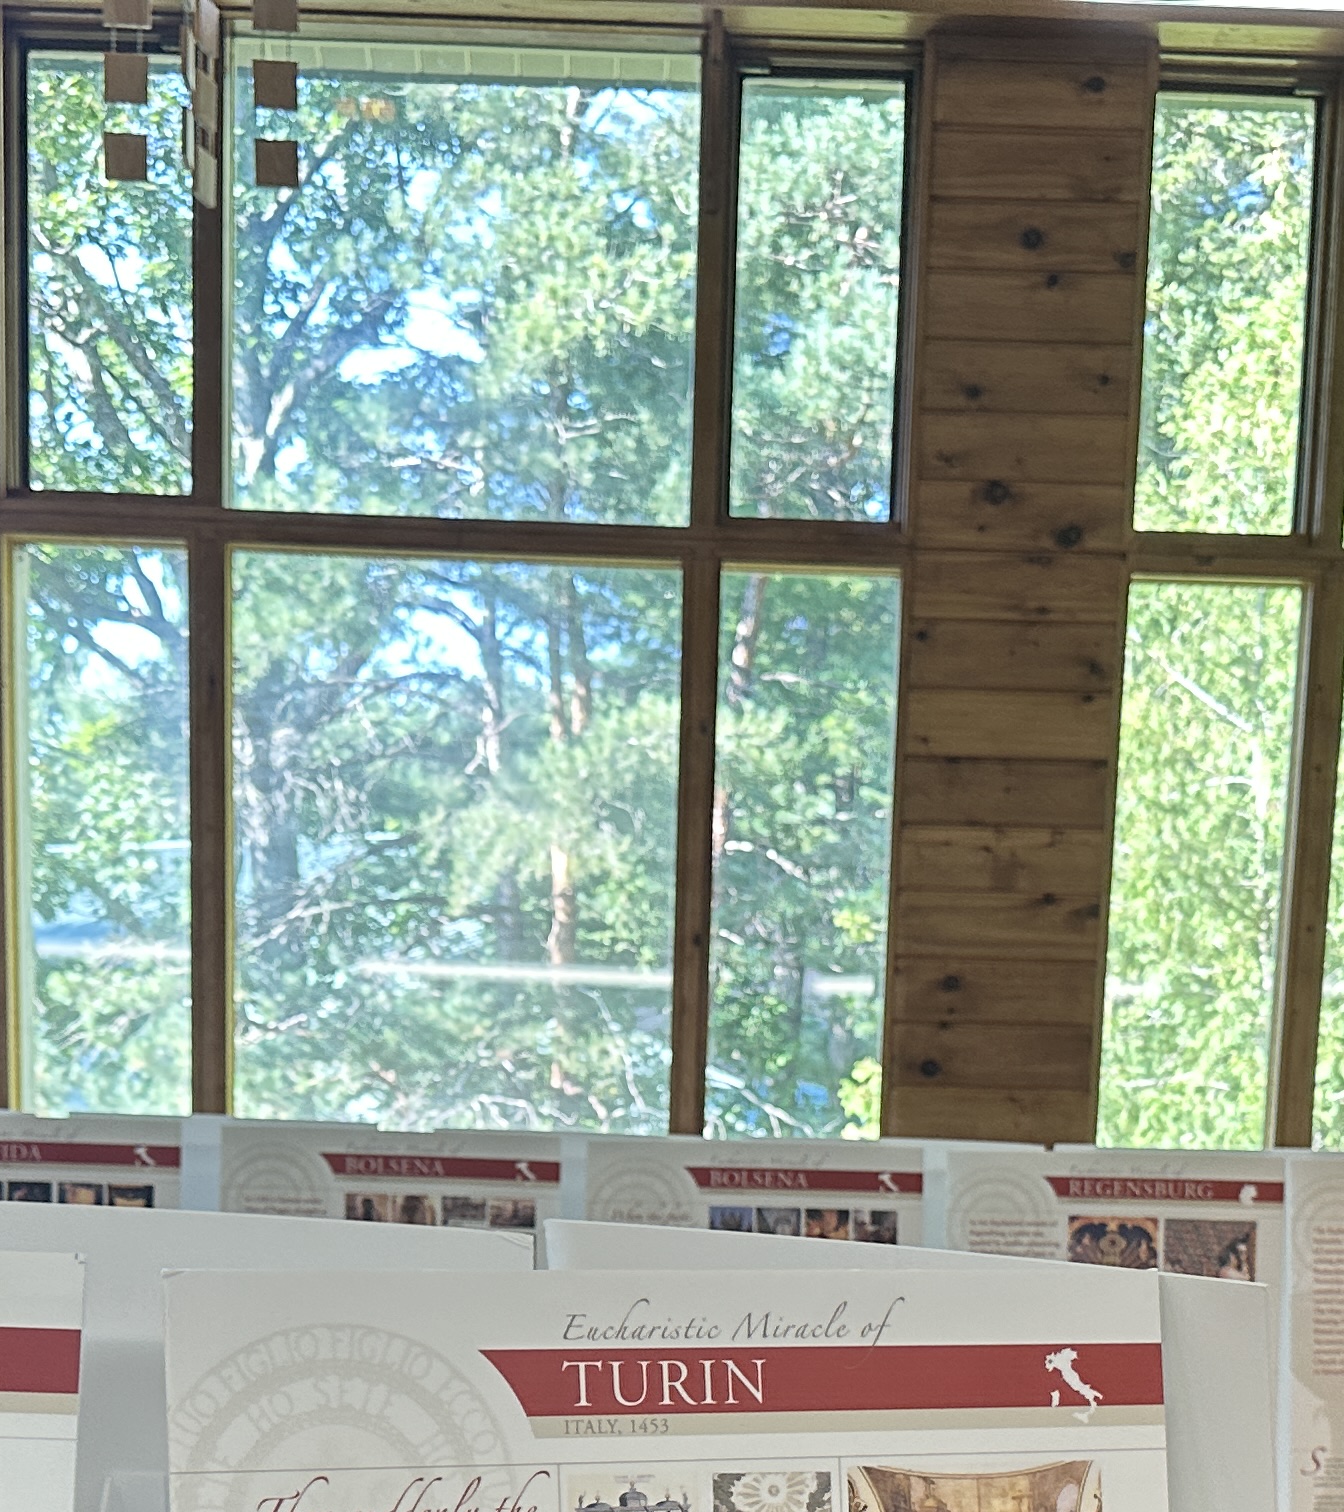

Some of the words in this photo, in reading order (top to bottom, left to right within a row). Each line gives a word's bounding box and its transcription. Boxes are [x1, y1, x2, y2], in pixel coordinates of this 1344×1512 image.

[344, 1157, 445, 1176] BOLSENA
[709, 1169, 809, 1188] BOLSENA
[1068, 1179, 1214, 1200] REGENSBURG
[562, 1297, 721, 1342] Eucharistic
[730, 1300, 851, 1342] Miracle
[859, 1296, 906, 1348] of
[561, 1358, 767, 1408] TURIN
[563, 1418, 623, 1436] ITALY,
[630, 1417, 670, 1434] 1453
